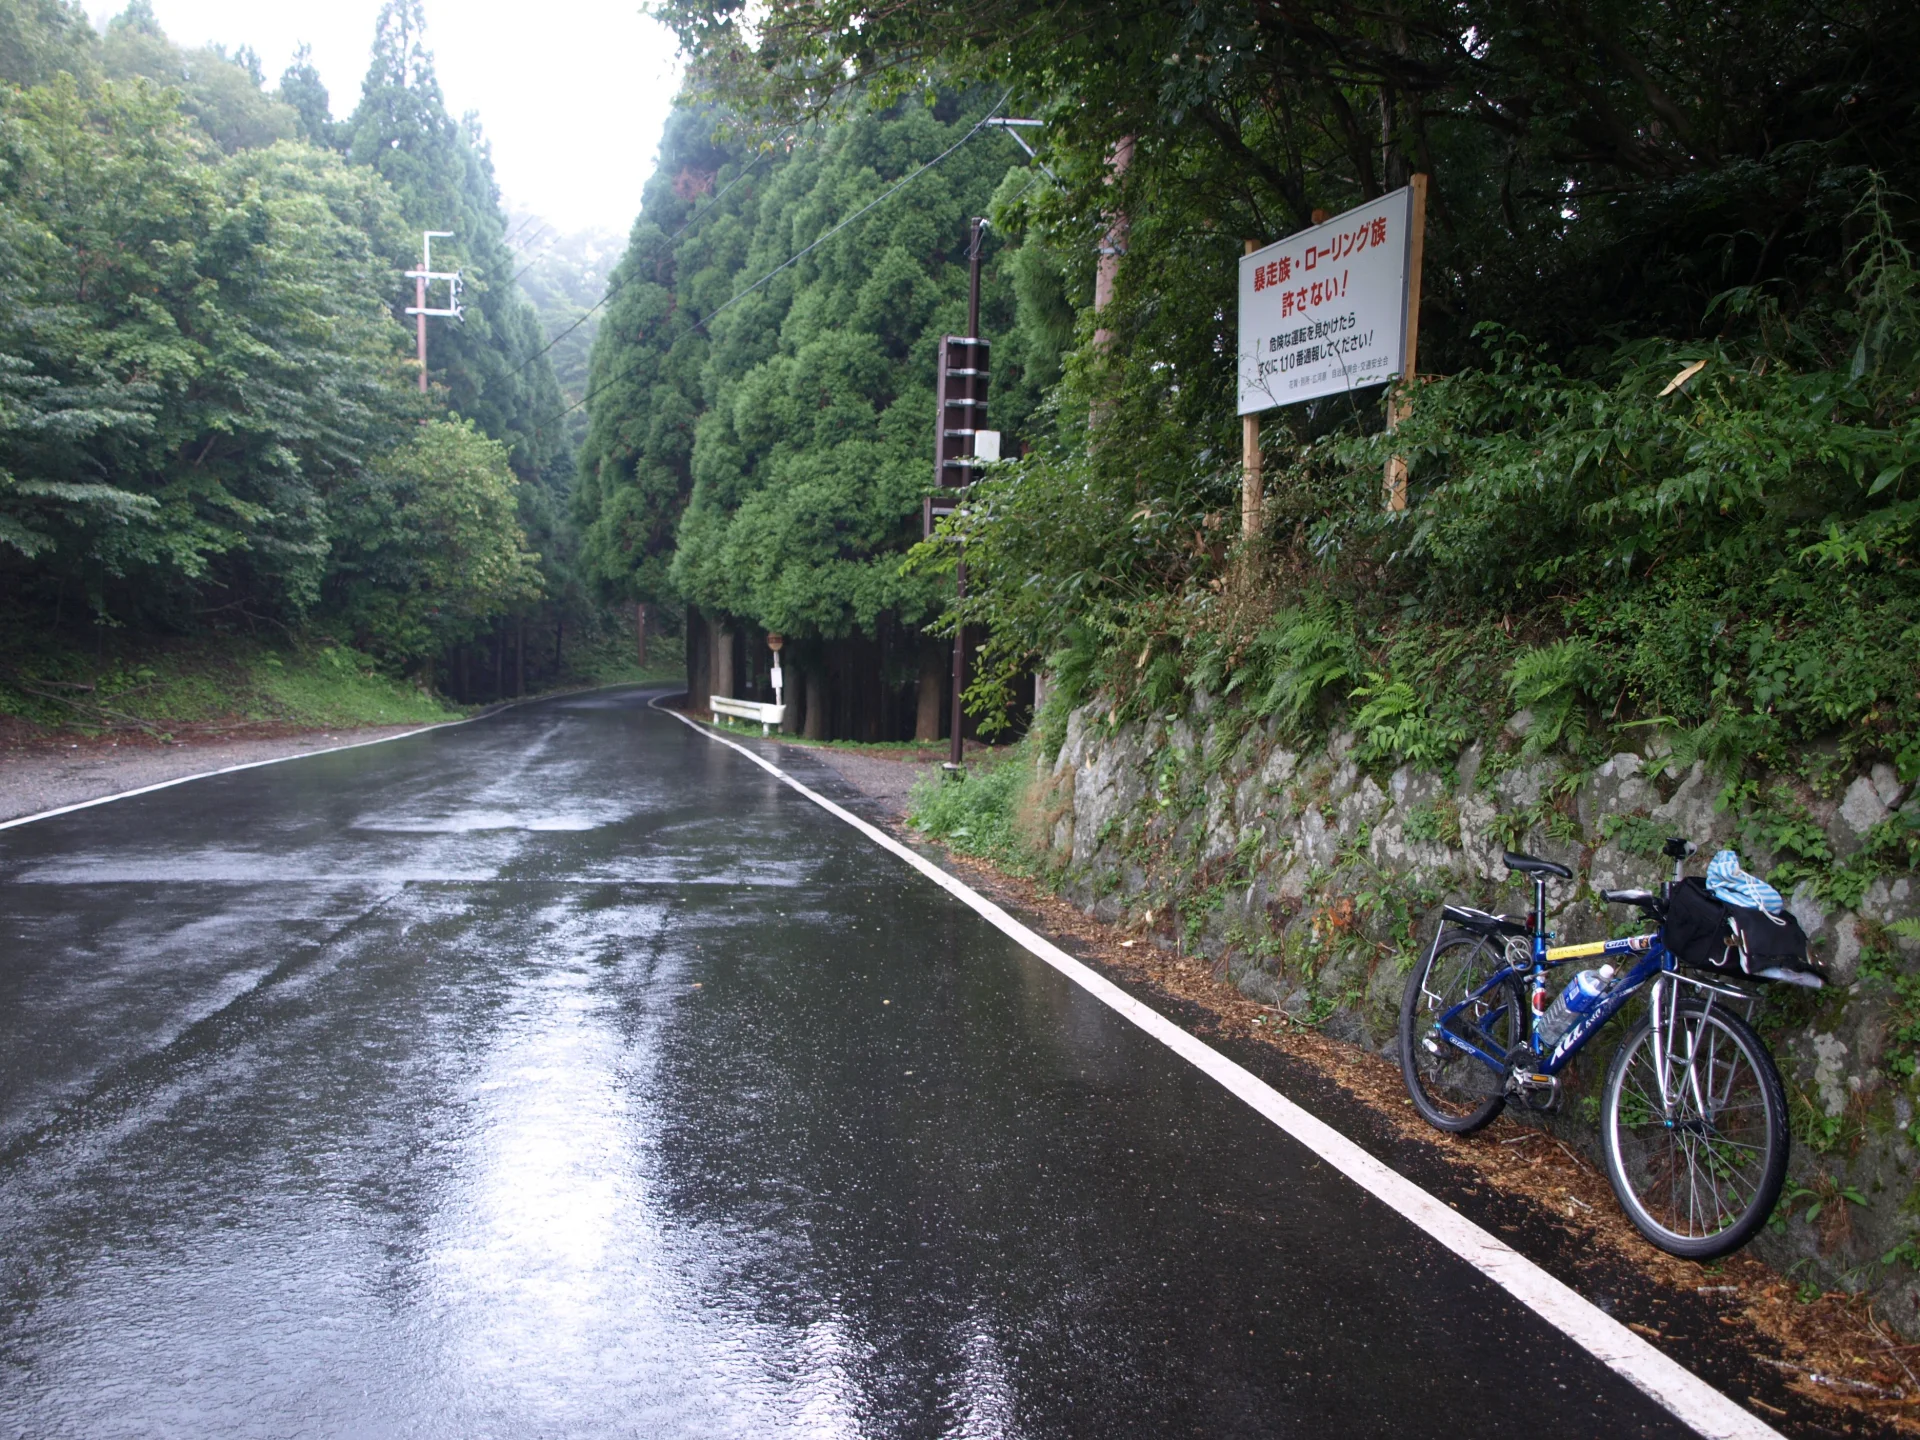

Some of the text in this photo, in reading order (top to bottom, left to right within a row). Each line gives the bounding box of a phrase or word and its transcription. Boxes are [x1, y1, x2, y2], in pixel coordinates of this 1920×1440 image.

[1254, 217, 1386, 291] 暴走族・ローリング族
[1281, 269, 1348, 318] 許さない！
[1269, 312, 1356, 352] 危険な運転を見かけたら
